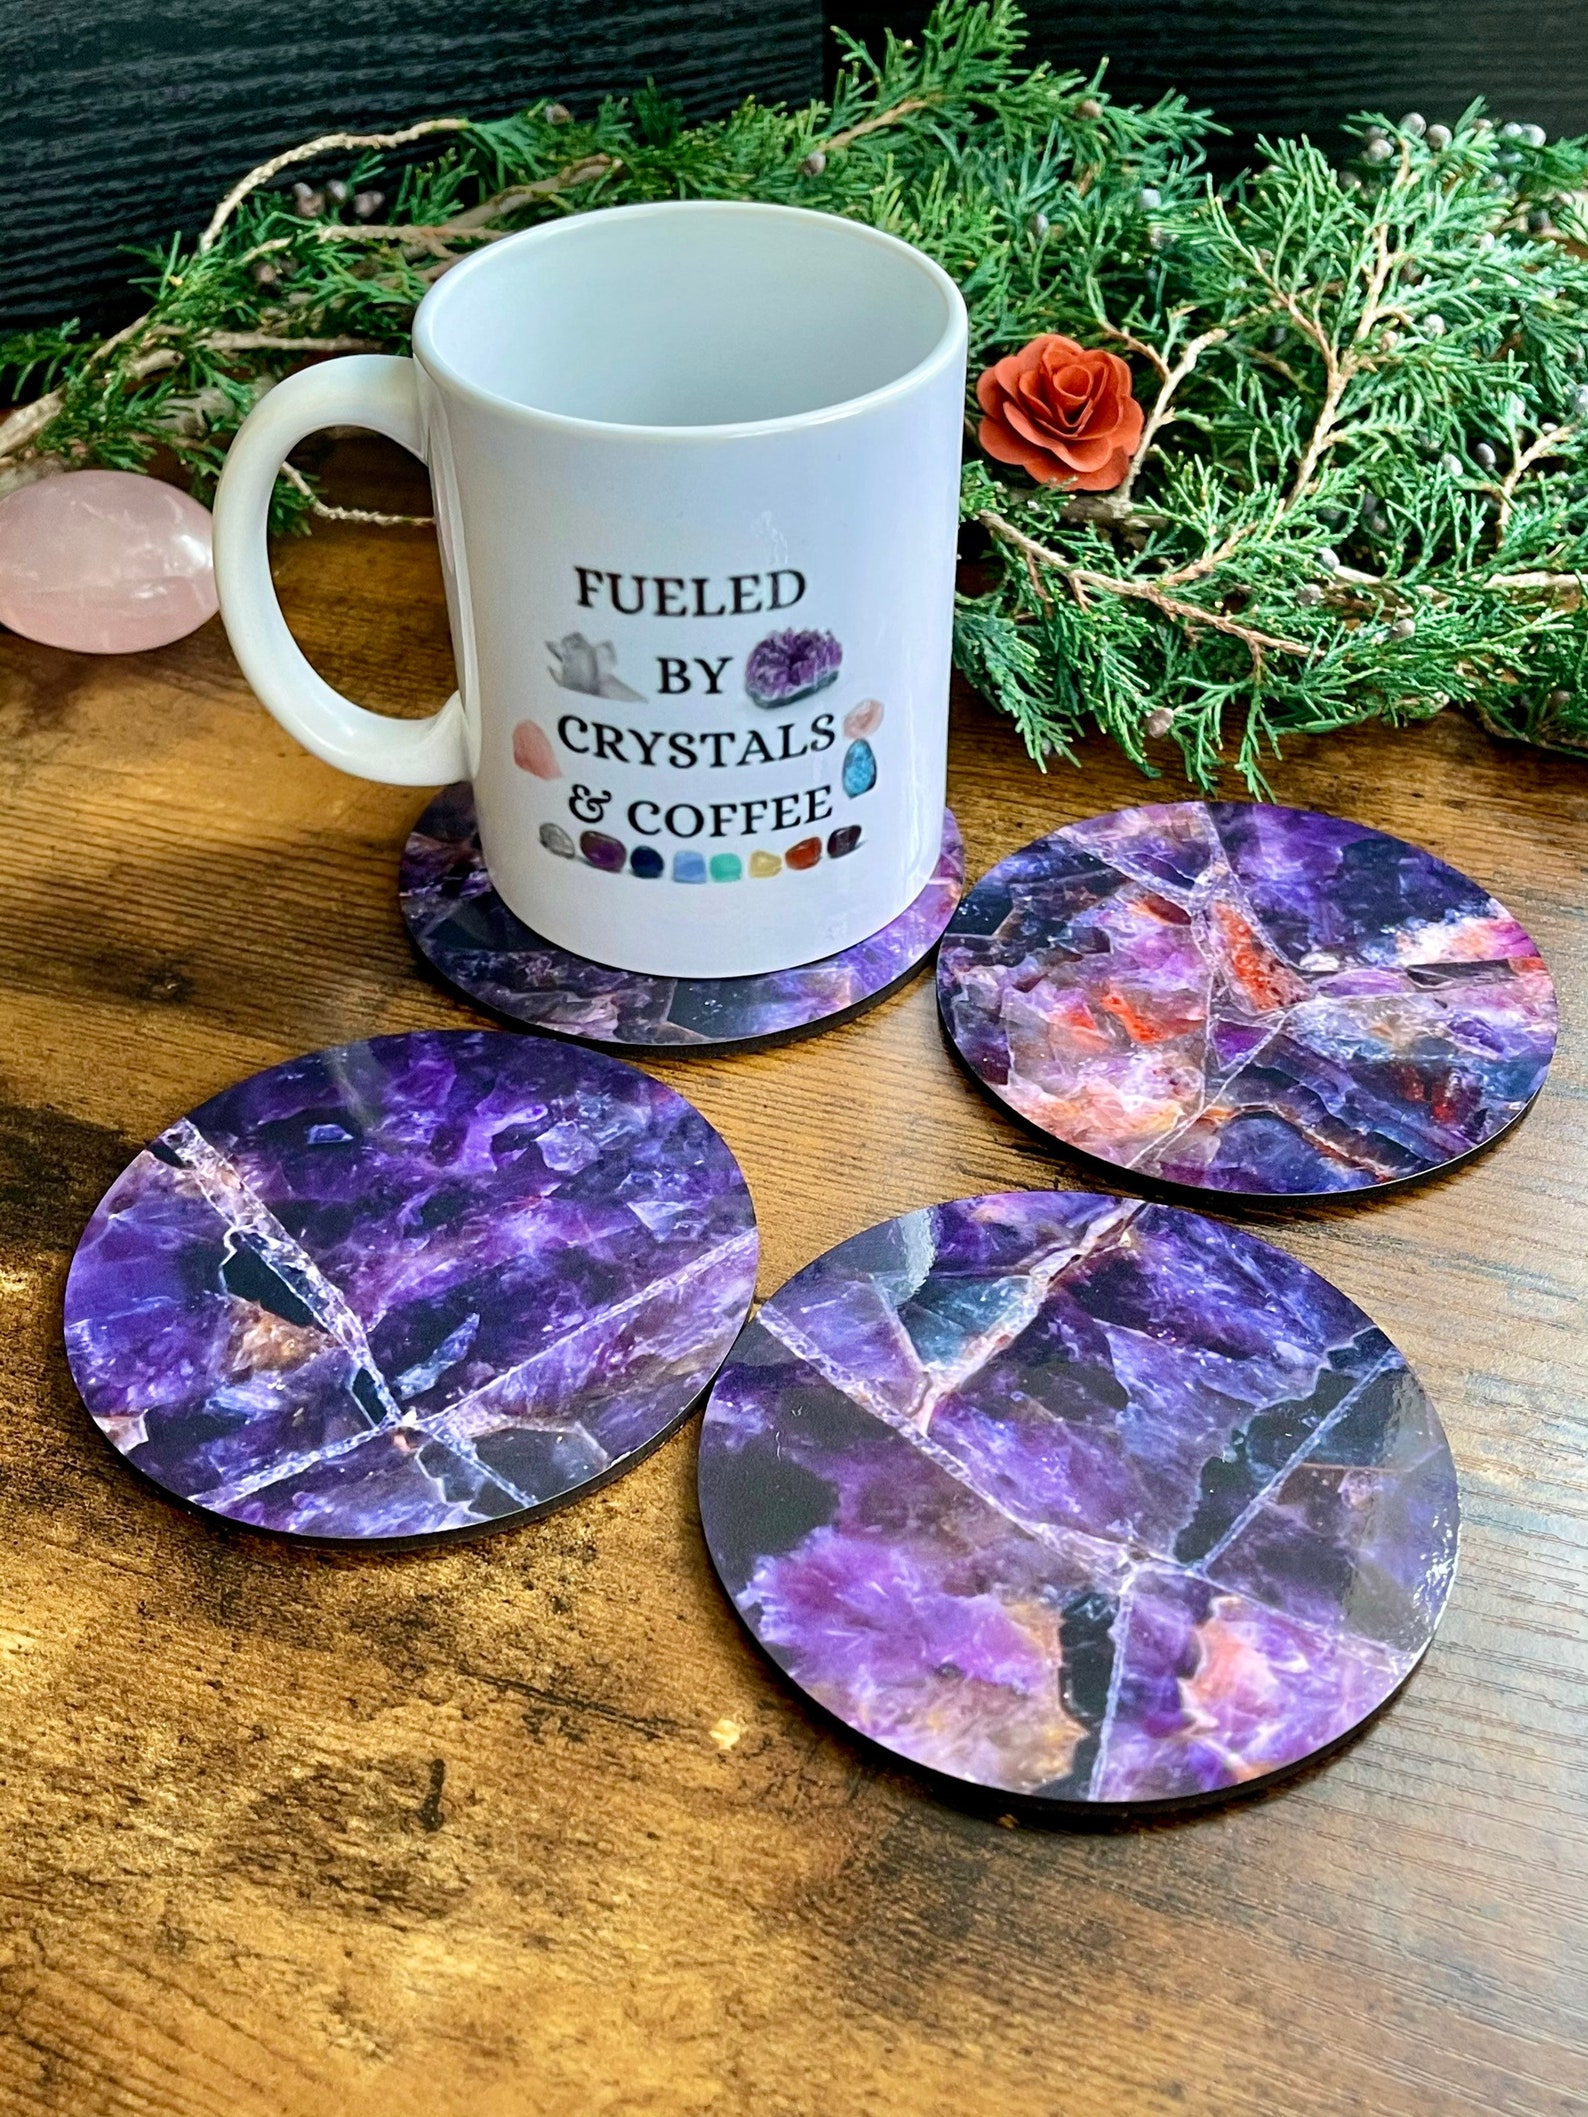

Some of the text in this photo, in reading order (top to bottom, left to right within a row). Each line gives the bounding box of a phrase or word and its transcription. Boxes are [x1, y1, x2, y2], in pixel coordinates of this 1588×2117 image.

[574, 566, 806, 617] FUELED
[656, 657, 734, 695] BY
[557, 714, 836, 769] CRYSTALS
[568, 783, 833, 839] & COFFEE
